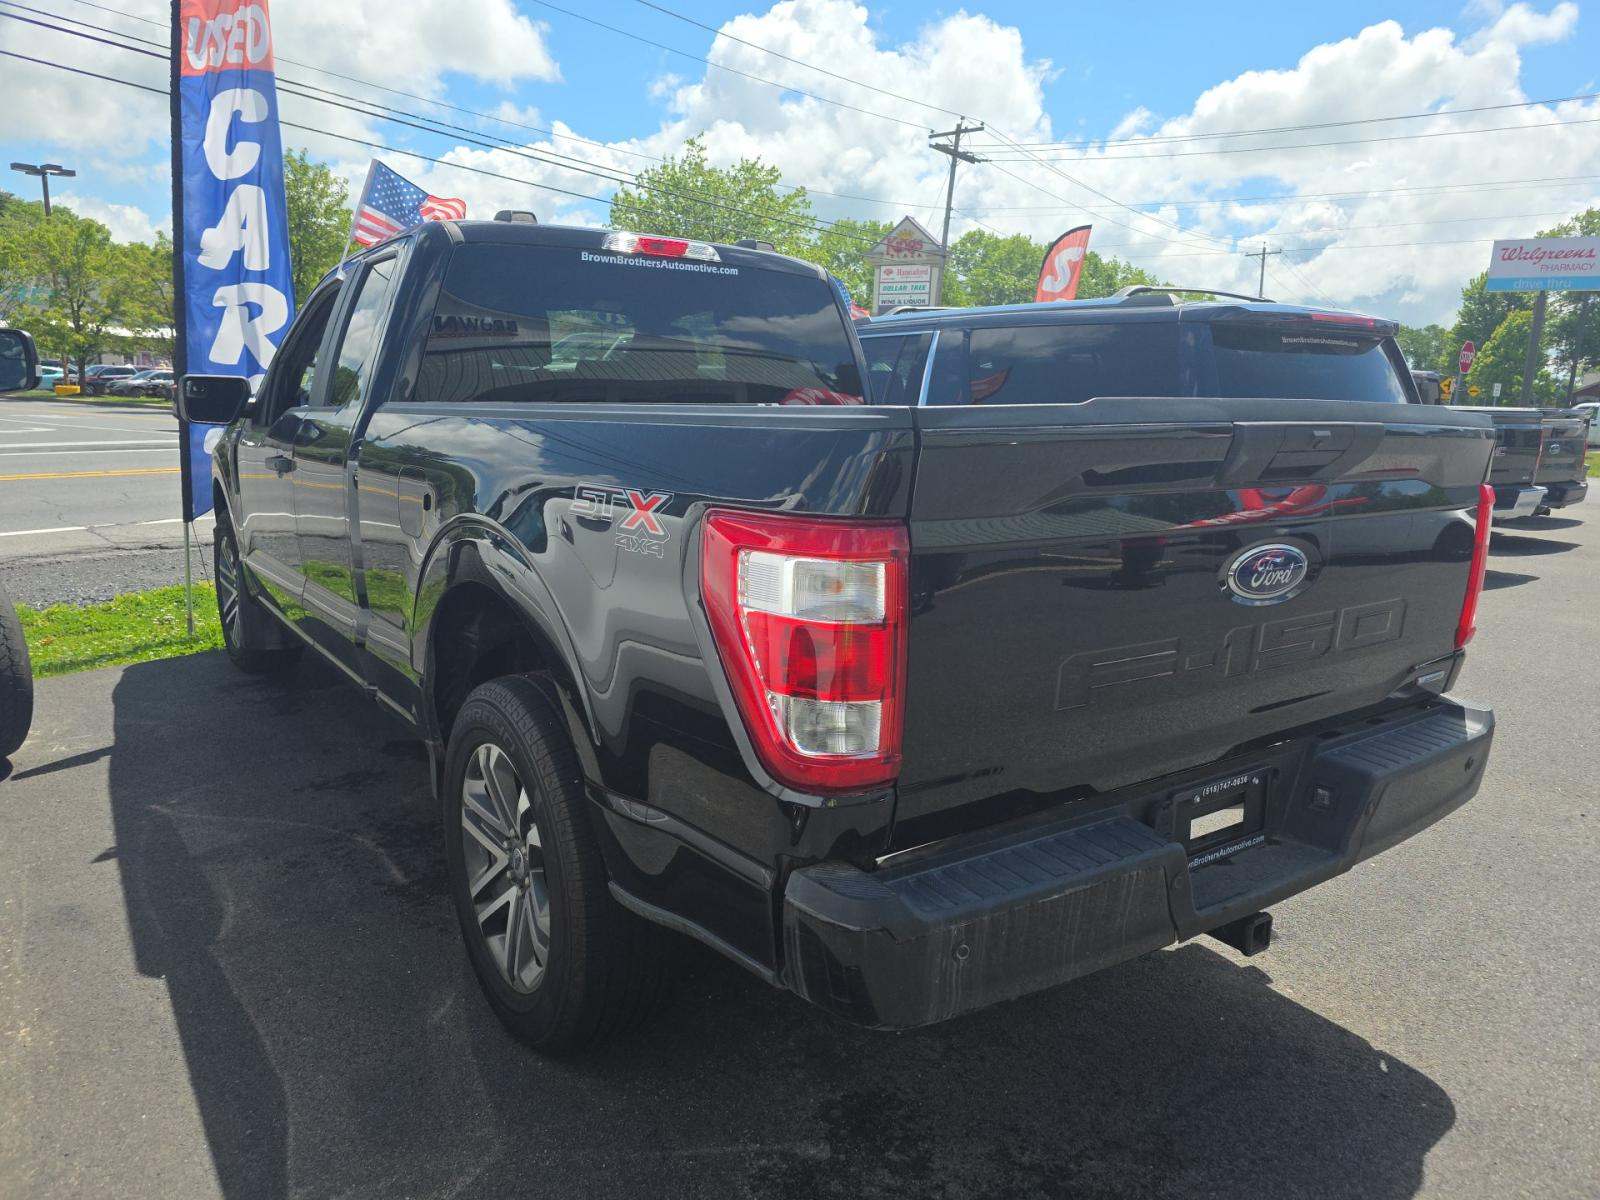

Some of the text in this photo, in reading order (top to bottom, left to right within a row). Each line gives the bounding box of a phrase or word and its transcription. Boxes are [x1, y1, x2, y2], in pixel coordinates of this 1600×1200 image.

[186, 4, 270, 70] USED
[581, 251, 738, 276] BrownBrothersAutomotive.com
[1500, 246, 1597, 265] Walgreens
[1540, 263, 1595, 271] PHARMACY
[197, 88, 288, 454] CAR
[1042, 247, 1084, 301] S
[1514, 278, 1572, 288] drive thru
[883, 284, 907, 292] DOLLAR
[1460, 351, 1475, 363] STOP
[569, 481, 674, 541] STX
[1251, 553, 1295, 588] Ford
[1055, 599, 1408, 710] F-150
